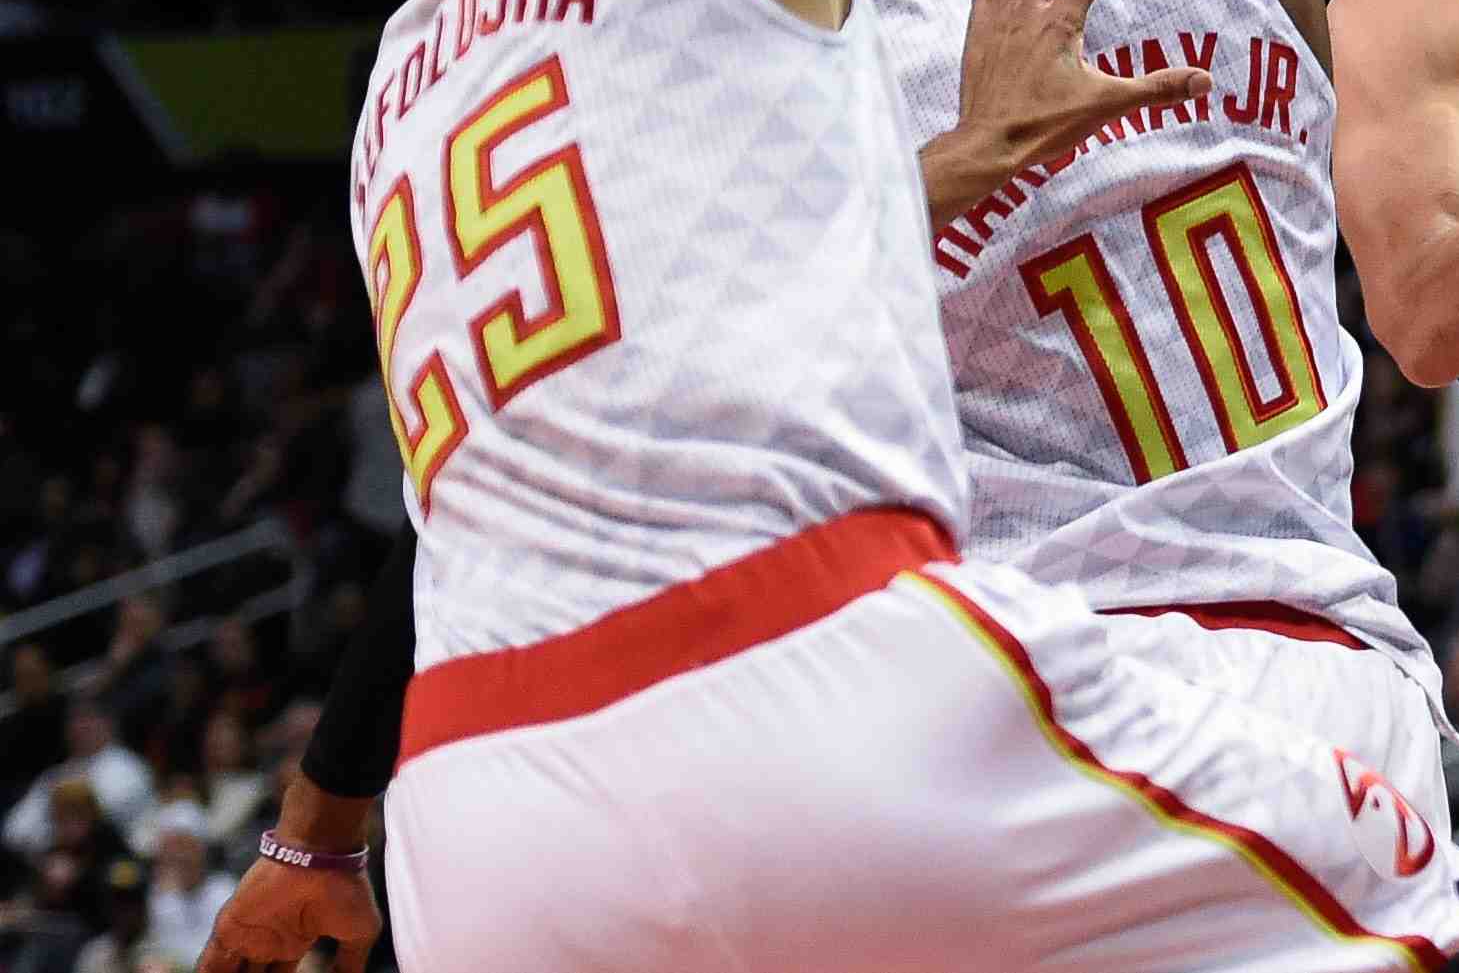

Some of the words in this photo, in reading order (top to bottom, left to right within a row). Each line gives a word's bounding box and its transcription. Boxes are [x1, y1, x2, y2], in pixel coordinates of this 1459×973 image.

[1223, 37, 1309, 145] JR.
[368, 52, 622, 524] 25
[1017, 160, 1329, 486] 10
